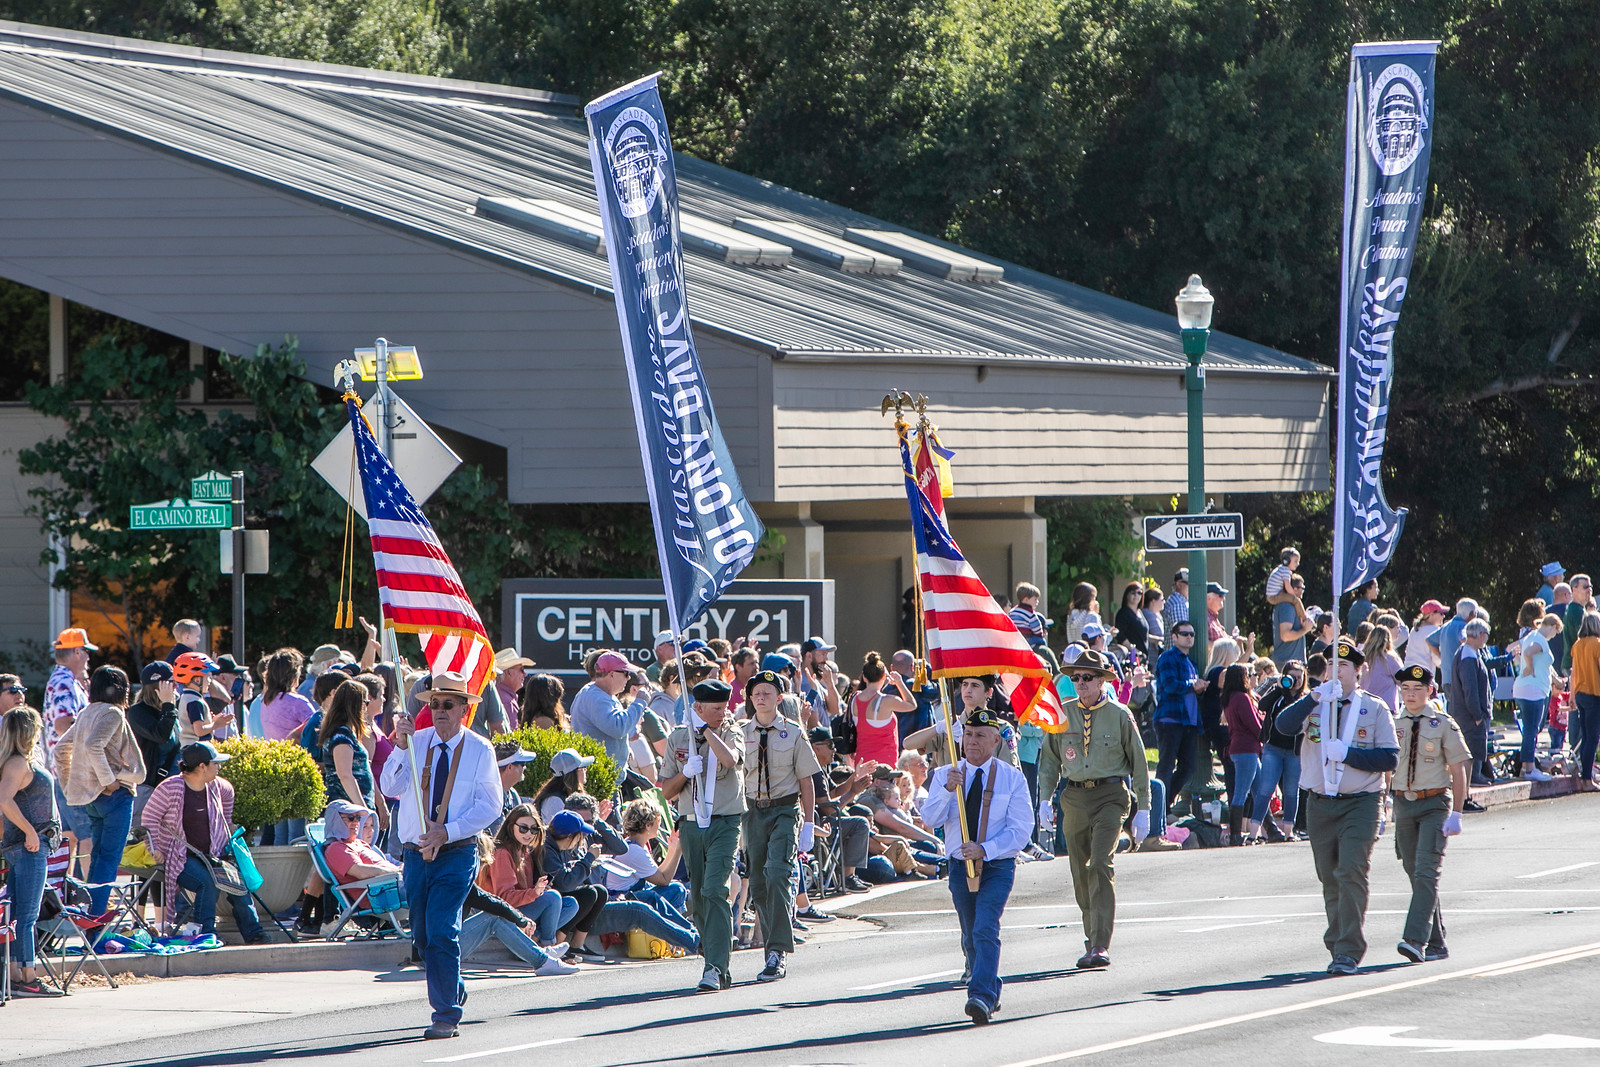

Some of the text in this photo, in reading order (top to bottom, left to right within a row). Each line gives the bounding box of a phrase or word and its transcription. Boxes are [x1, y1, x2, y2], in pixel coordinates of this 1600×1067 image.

[657, 305, 704, 420] DAYS
[647, 324, 717, 603] Atascadero
[194, 482, 231, 498] EAST MALL
[135, 508, 222, 526] EL CAMINO REAL
[1176, 524, 1233, 540] ONE WAY
[747, 608, 788, 642] 21
